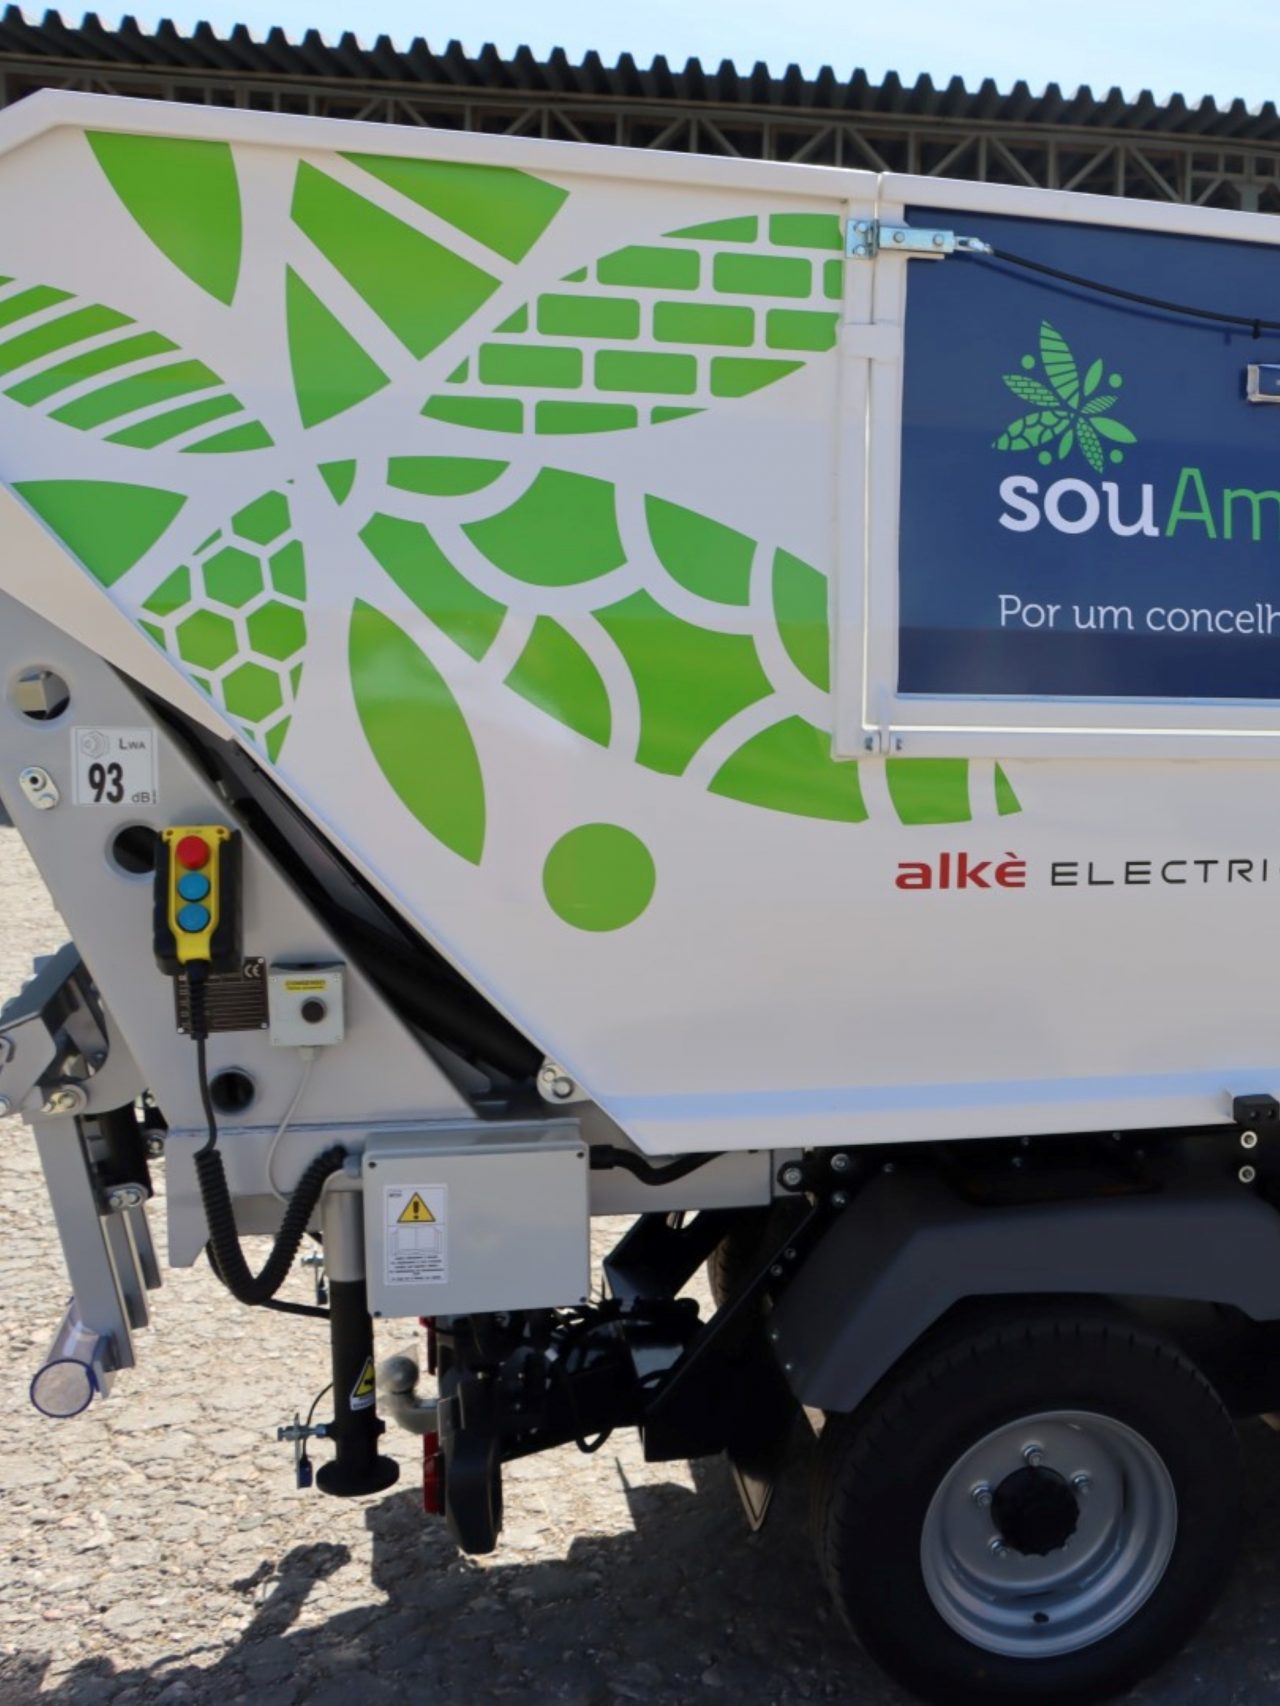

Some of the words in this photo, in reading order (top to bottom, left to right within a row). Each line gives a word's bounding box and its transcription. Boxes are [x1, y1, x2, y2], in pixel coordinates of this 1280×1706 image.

[999, 594, 1061, 628] Por
[1073, 605, 1134, 630] um
[88, 762, 125, 804] 93
[131, 791, 151, 803] dB
[895, 851, 1027, 890] alkè
